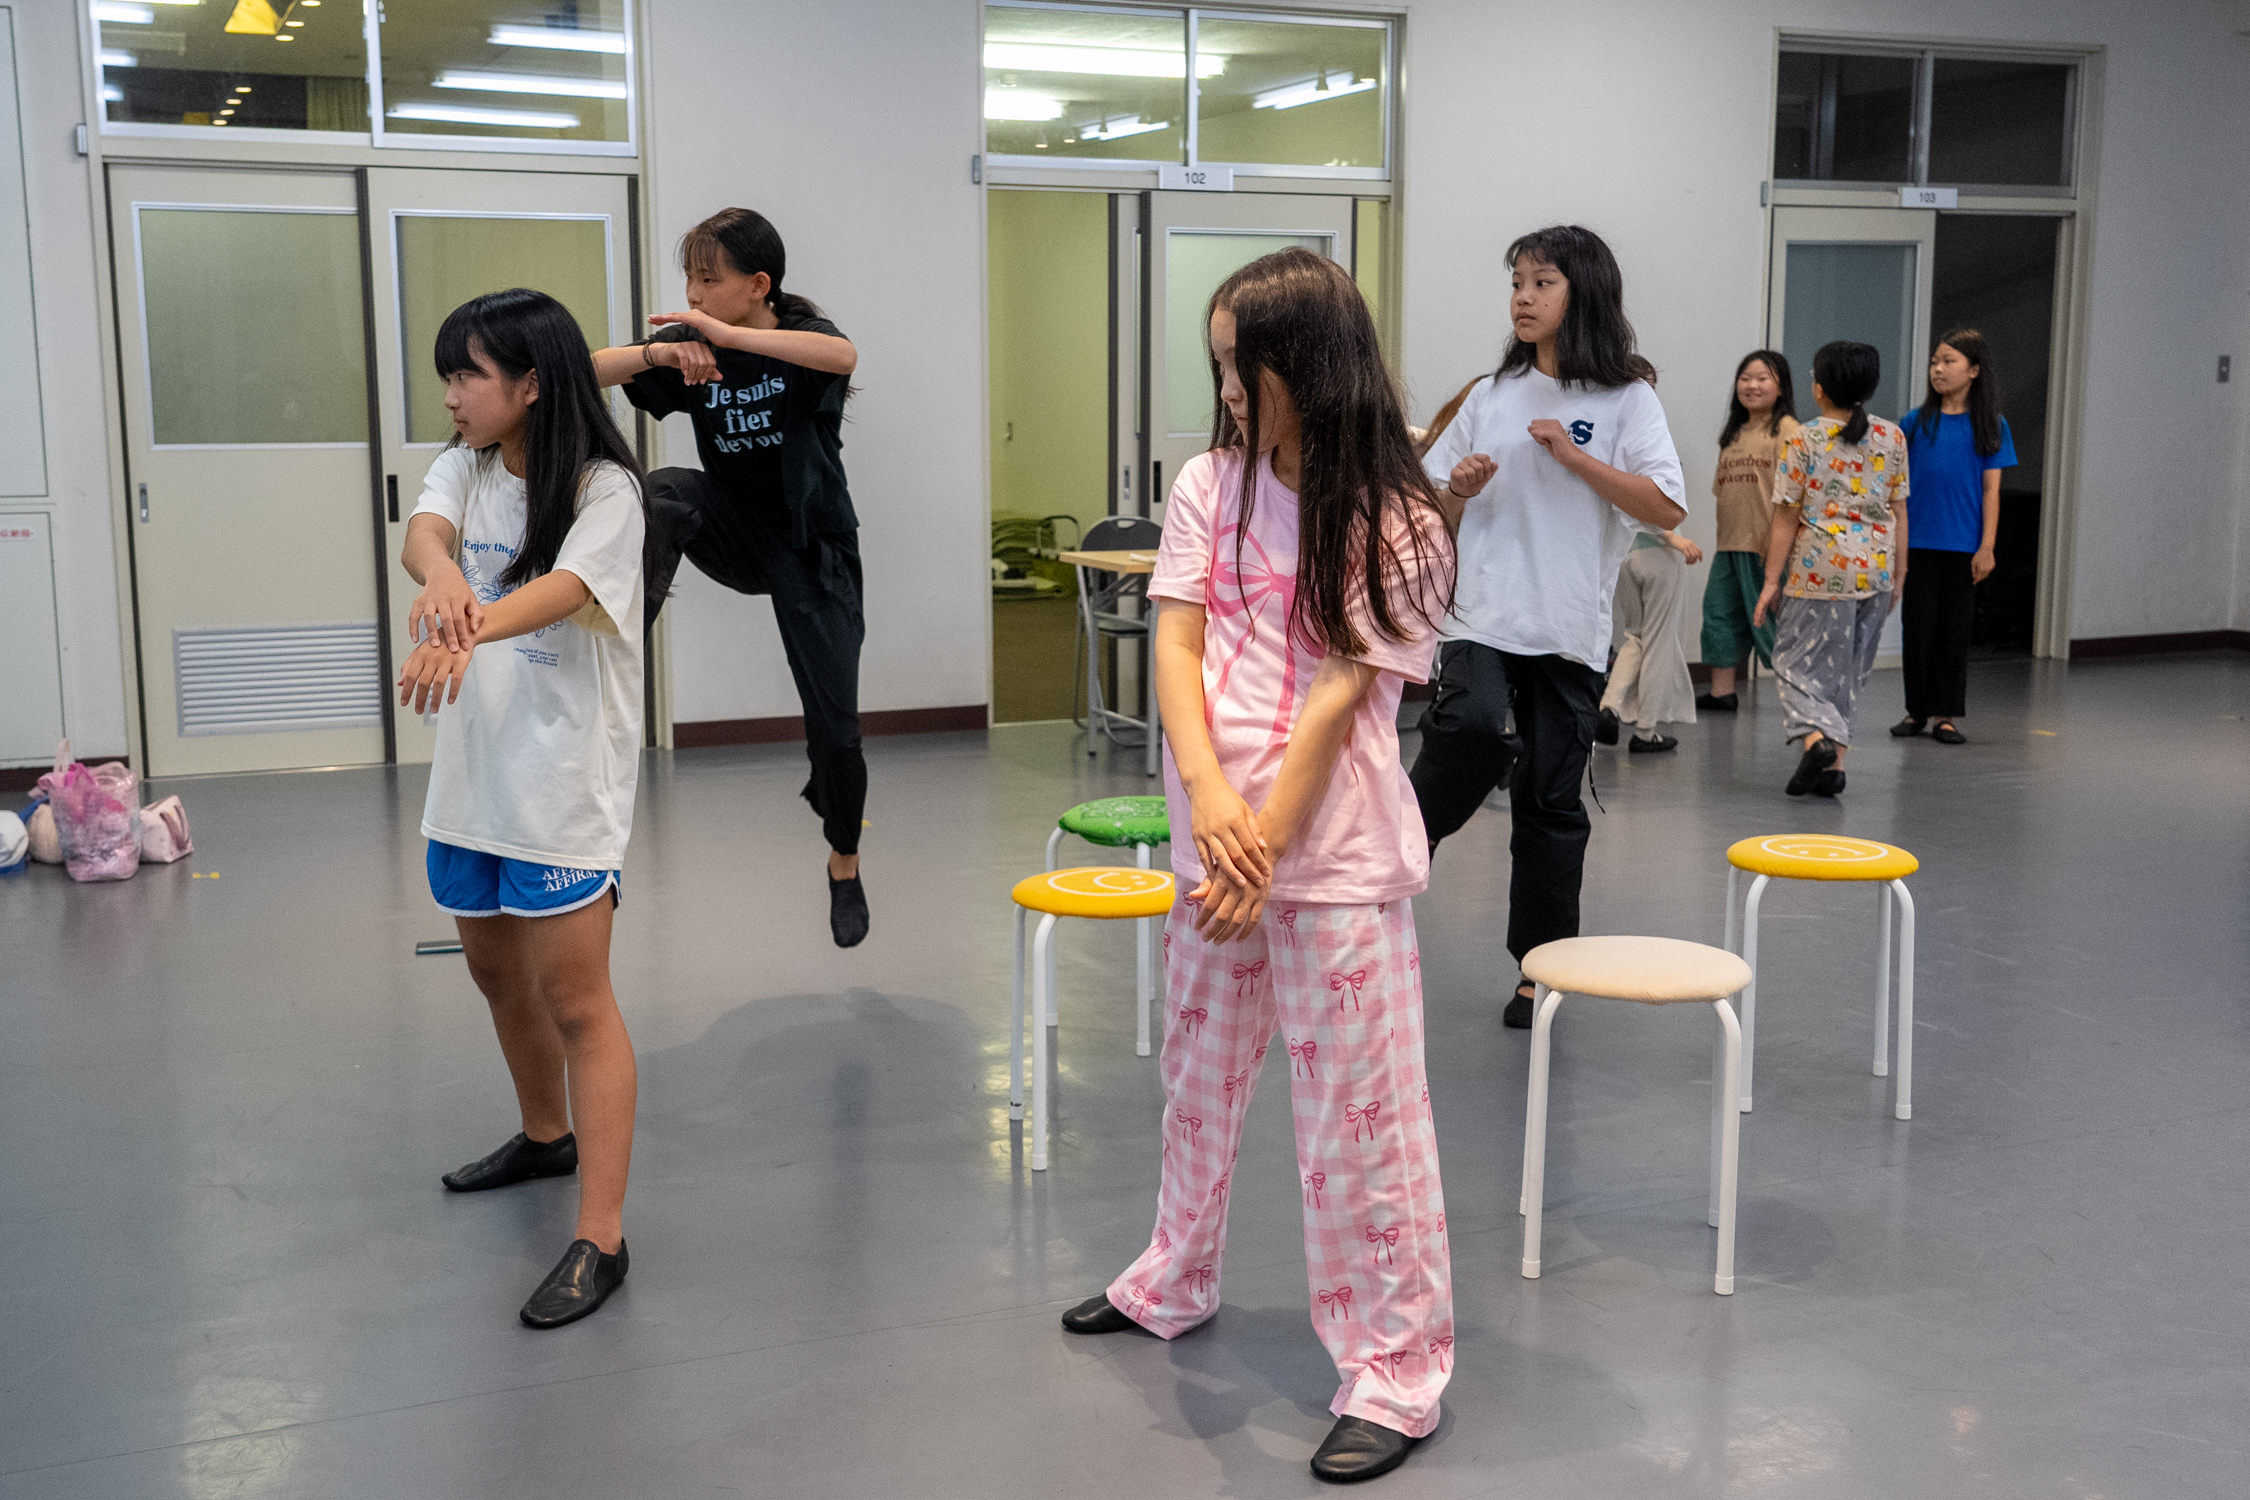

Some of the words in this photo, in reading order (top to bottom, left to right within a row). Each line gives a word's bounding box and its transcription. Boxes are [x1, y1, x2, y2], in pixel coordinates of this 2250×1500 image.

[1184, 172, 1206, 185] 102
[1919, 192, 1936, 204] 103
[705, 382, 732, 409] Je
[735, 373, 786, 405] suis
[724, 408, 773, 434] fier
[463, 539, 492, 554] Enjoy
[544, 868, 599, 892] AFFIRM
